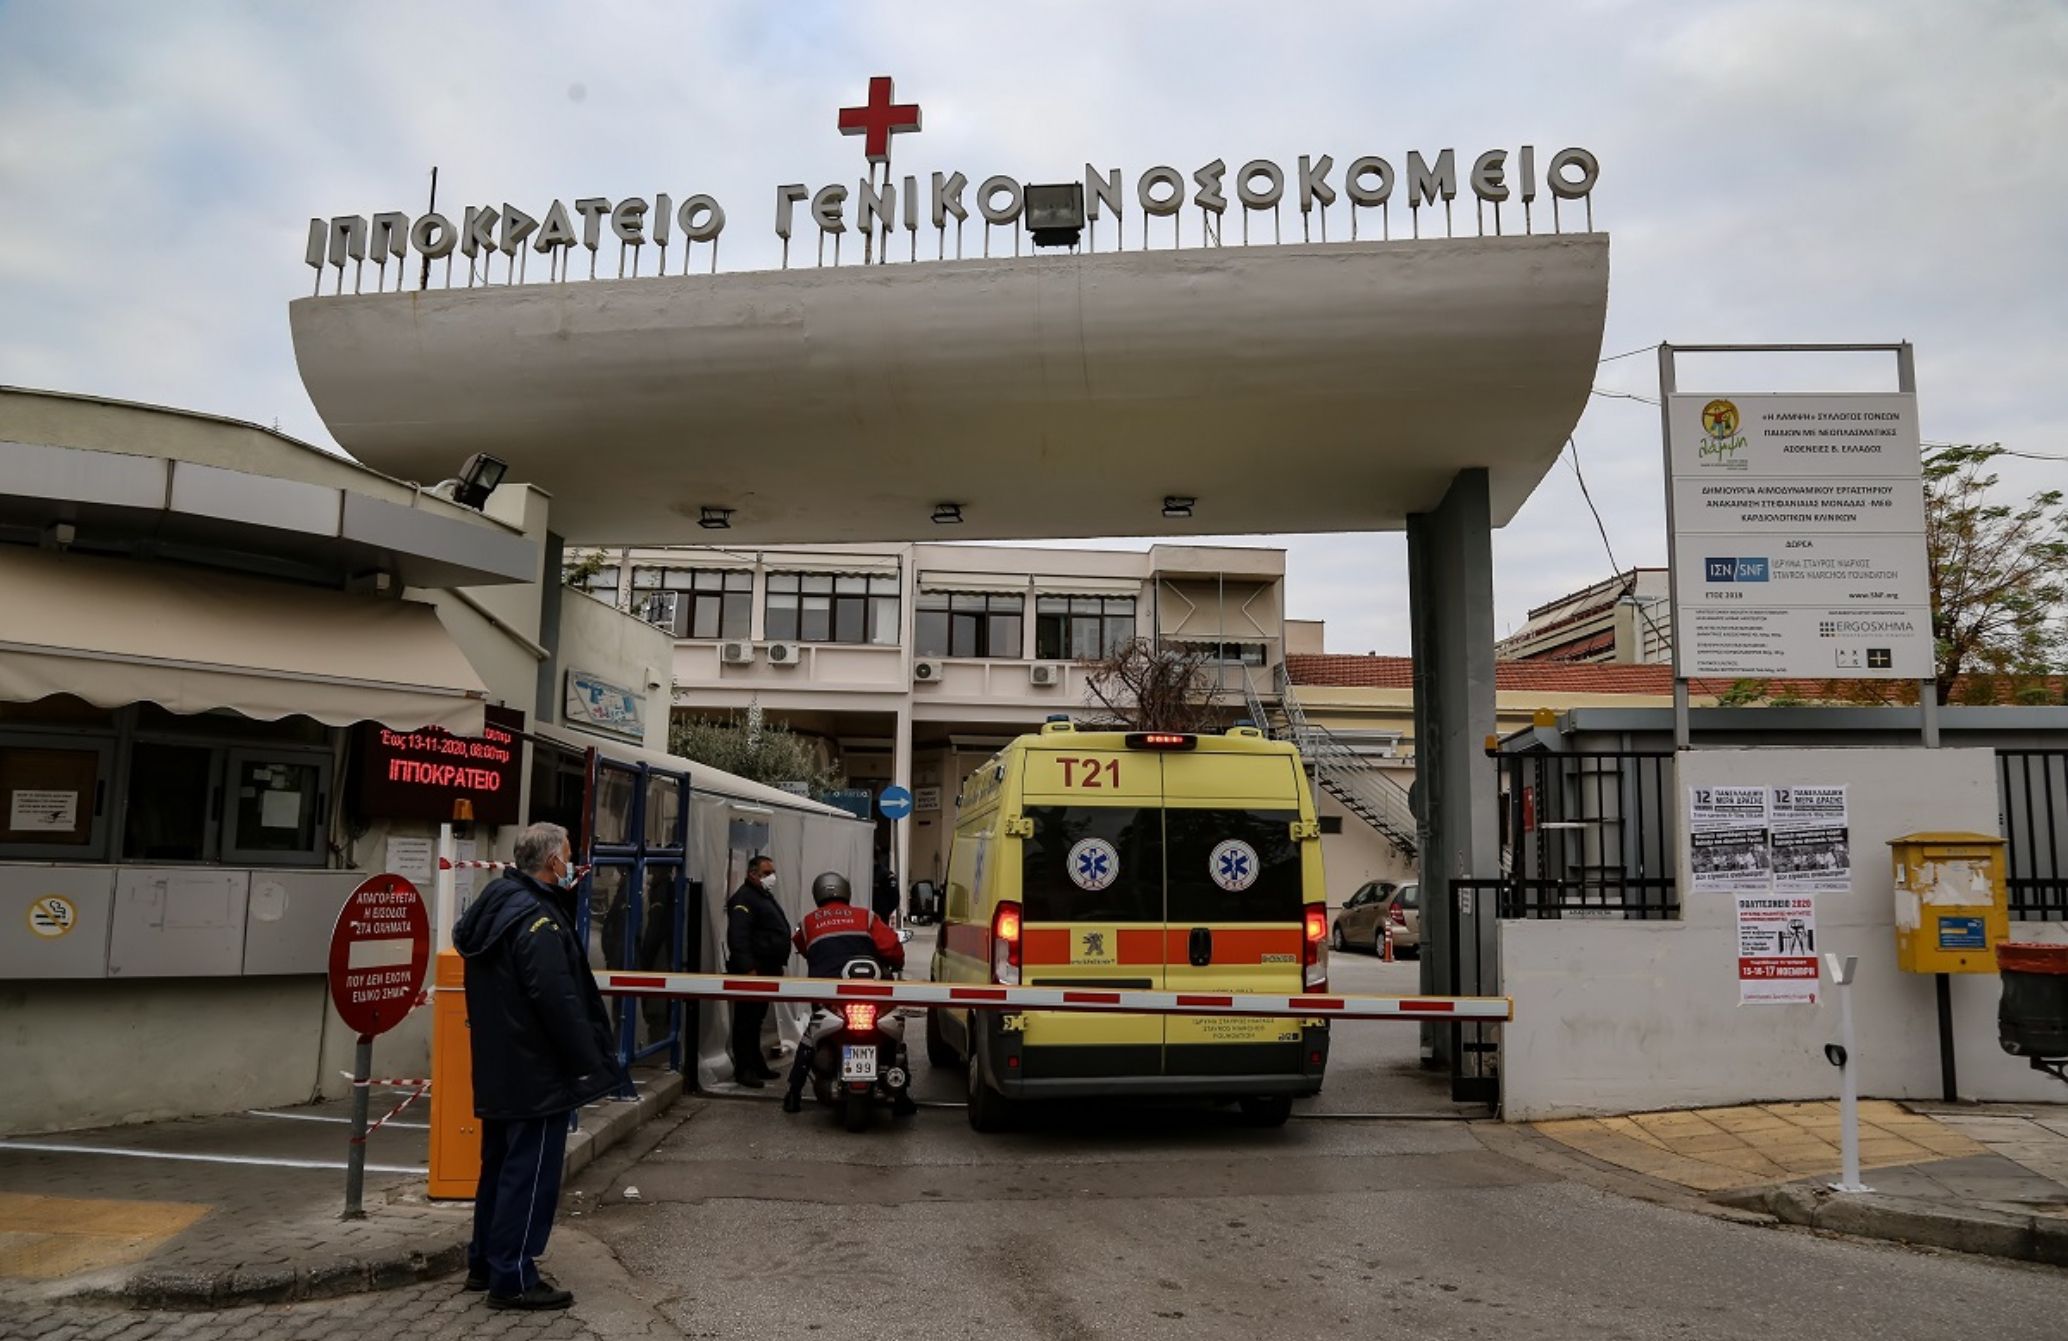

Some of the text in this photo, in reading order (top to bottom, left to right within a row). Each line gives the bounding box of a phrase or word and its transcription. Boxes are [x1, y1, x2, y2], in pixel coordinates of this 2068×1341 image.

[305, 145, 1600, 269] ΙΠΠΟΚΡΑΤΕΙΟ ΓΕΝΙΚΟ ΝΟΣΟΚΟΜΕΙΟ
[1817, 413, 1861, 421] ΣΥΛΛΟΓΟΣ
[1864, 413, 1900, 421] ΓΟΝΕΩΝ
[1802, 429, 1816, 437] ΜΕ
[1818, 429, 1897, 437] ΝΕΟΠΛΑΣΜΑΤΙΚΕΣ
[1783, 445, 1829, 453] ΑΣΘΕΝΕΙΕΣ
[1842, 445, 1882, 453] ΕΛΛΑΔΟΣ
[1702, 486, 1892, 494] ΔΗΜΙΟΥΡΓΙΑ ΑΙΜΟΔΥΝΑΜΙΚΟΥ ΕΡΓΑΣΤΗΡΙΟΥ
[1706, 500, 1760, 508] ΑΝΑΚΑΙΝΙΣΗ
[1821, 500, 1865, 508] ΜΟΝΑΔΑΣ
[1742, 514, 1857, 522] ΚΑΡΔΙΟΛΟΓΙΚΩΝ ΚΛΙΝΙΚΩΝ
[1803, 559, 1836, 568] ΣΤΑΥΡΟΣ
[1773, 571, 1898, 579] STAVROS NIARCHOS FOUNDATION
[1837, 621, 1914, 631] ERGOSXHMA
[380, 729, 406, 750] Έως
[389, 758, 500, 791] ΙΠΠΟΚΡΑΤΕΙΟ
[1057, 758, 1120, 788] T21
[1696, 790, 1711, 803] 12
[1775, 790, 1790, 803] 12
[357, 893, 416, 904] ΑΠΑΓΟΡΕΥΕΤΑΙ
[372, 907, 407, 918] ΕΙΣΟΔΟΣ
[373, 921, 411, 933] ΟΧΗΜΑΤΑ
[346, 971, 411, 987] ΠΟΥ ΔΕΝ ΕΧΟΥΝ
[352, 990, 380, 1003] ΕΙΔΙΚΟ
